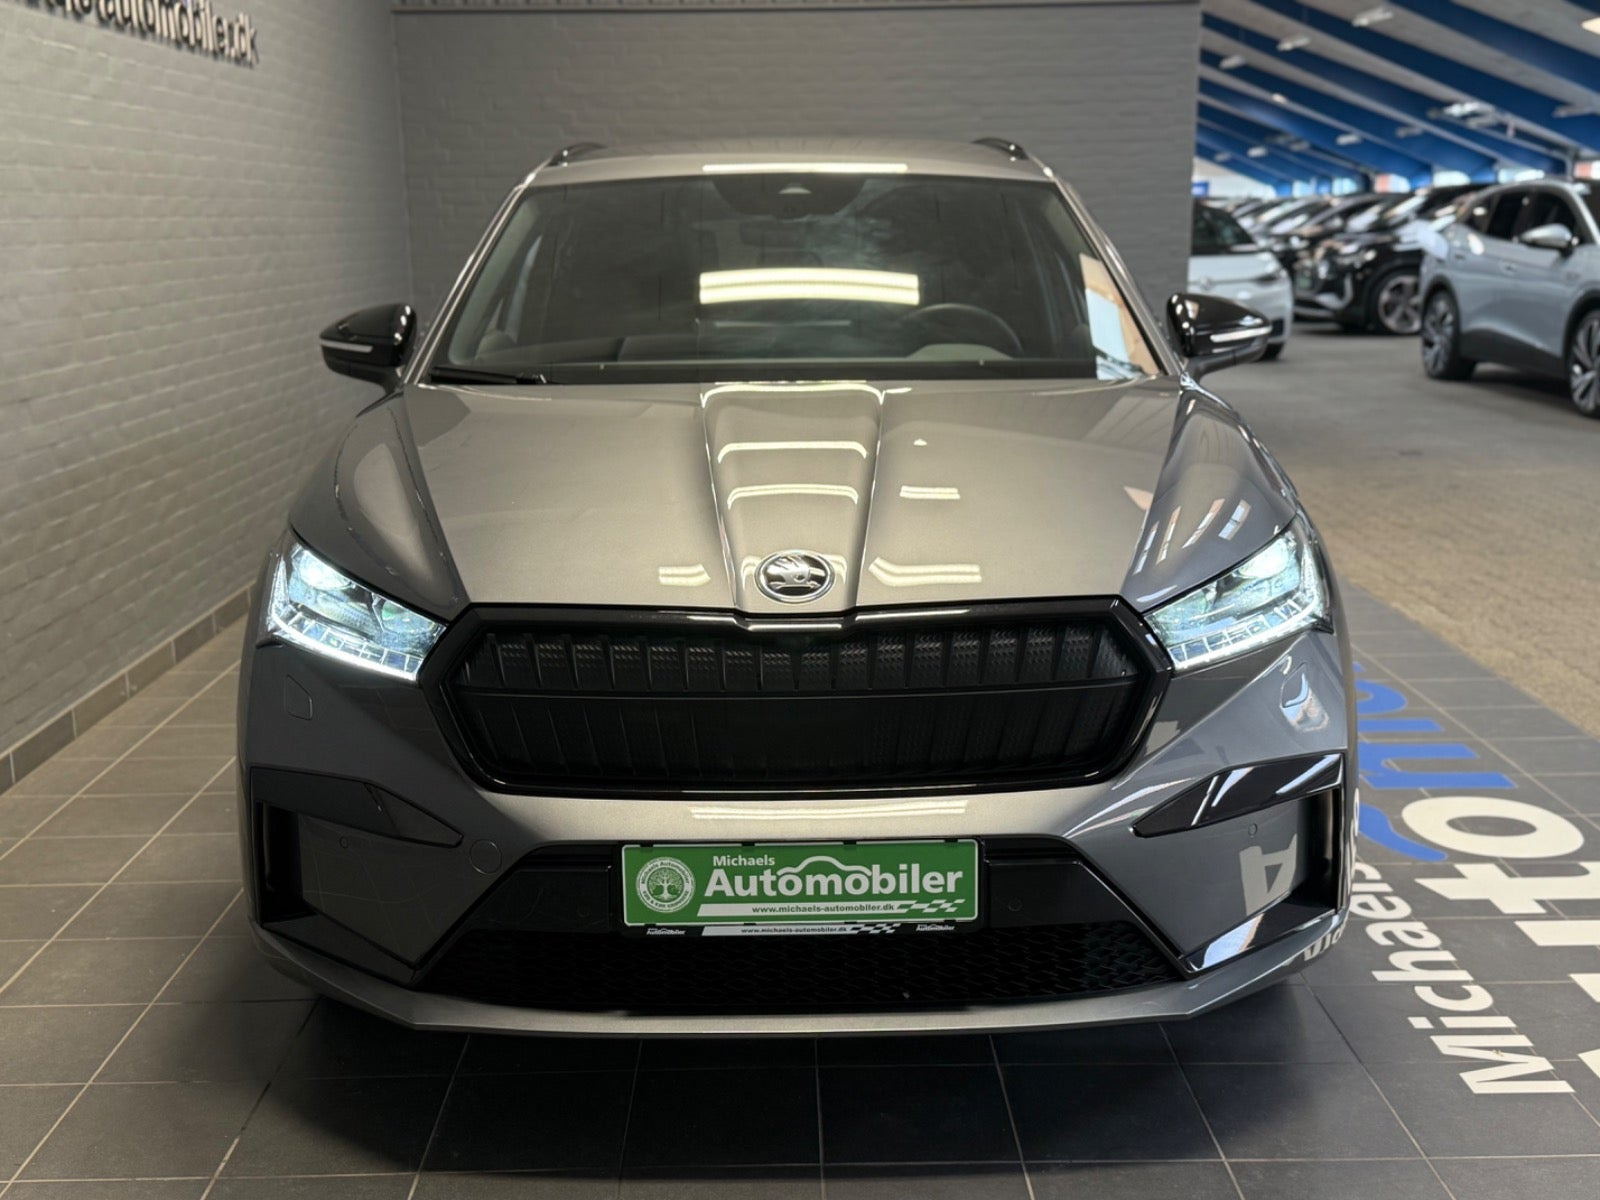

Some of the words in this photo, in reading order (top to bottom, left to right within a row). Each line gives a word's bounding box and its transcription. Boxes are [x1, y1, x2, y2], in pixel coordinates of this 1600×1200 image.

[713, 854, 776, 867] Michaels
[704, 863, 963, 897] Automobiler
[752, 903, 895, 913] www.michaels-automobiler.dk
[740, 926, 847, 934] www.michaels-automobiler.dk
